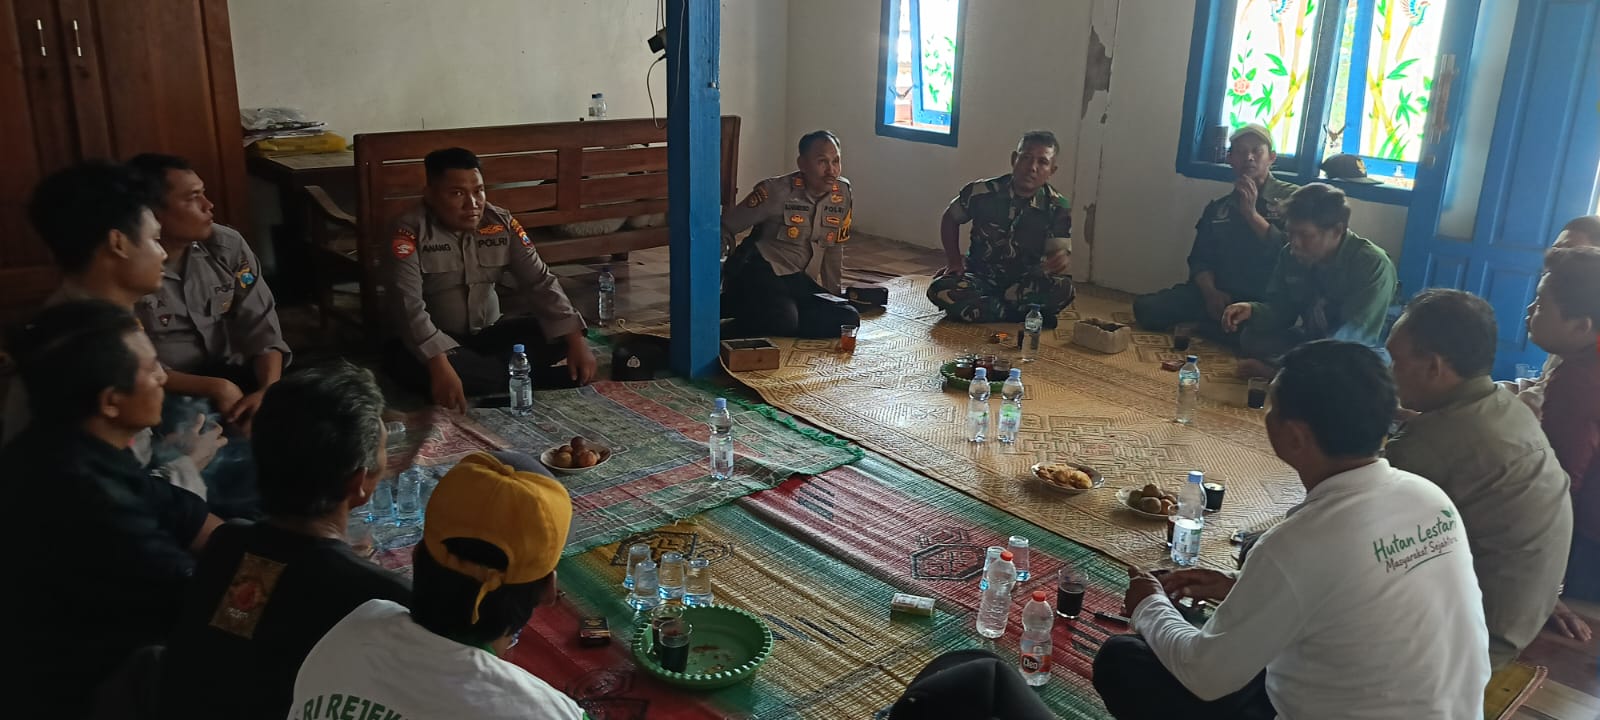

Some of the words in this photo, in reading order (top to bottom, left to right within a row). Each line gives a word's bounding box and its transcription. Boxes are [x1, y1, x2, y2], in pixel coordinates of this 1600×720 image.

[422, 243, 452, 252] ANANG
[478, 237, 508, 249] POLRI
[1373, 533, 1416, 562] Hutan
[1385, 544, 1429, 573] Masyarakat
